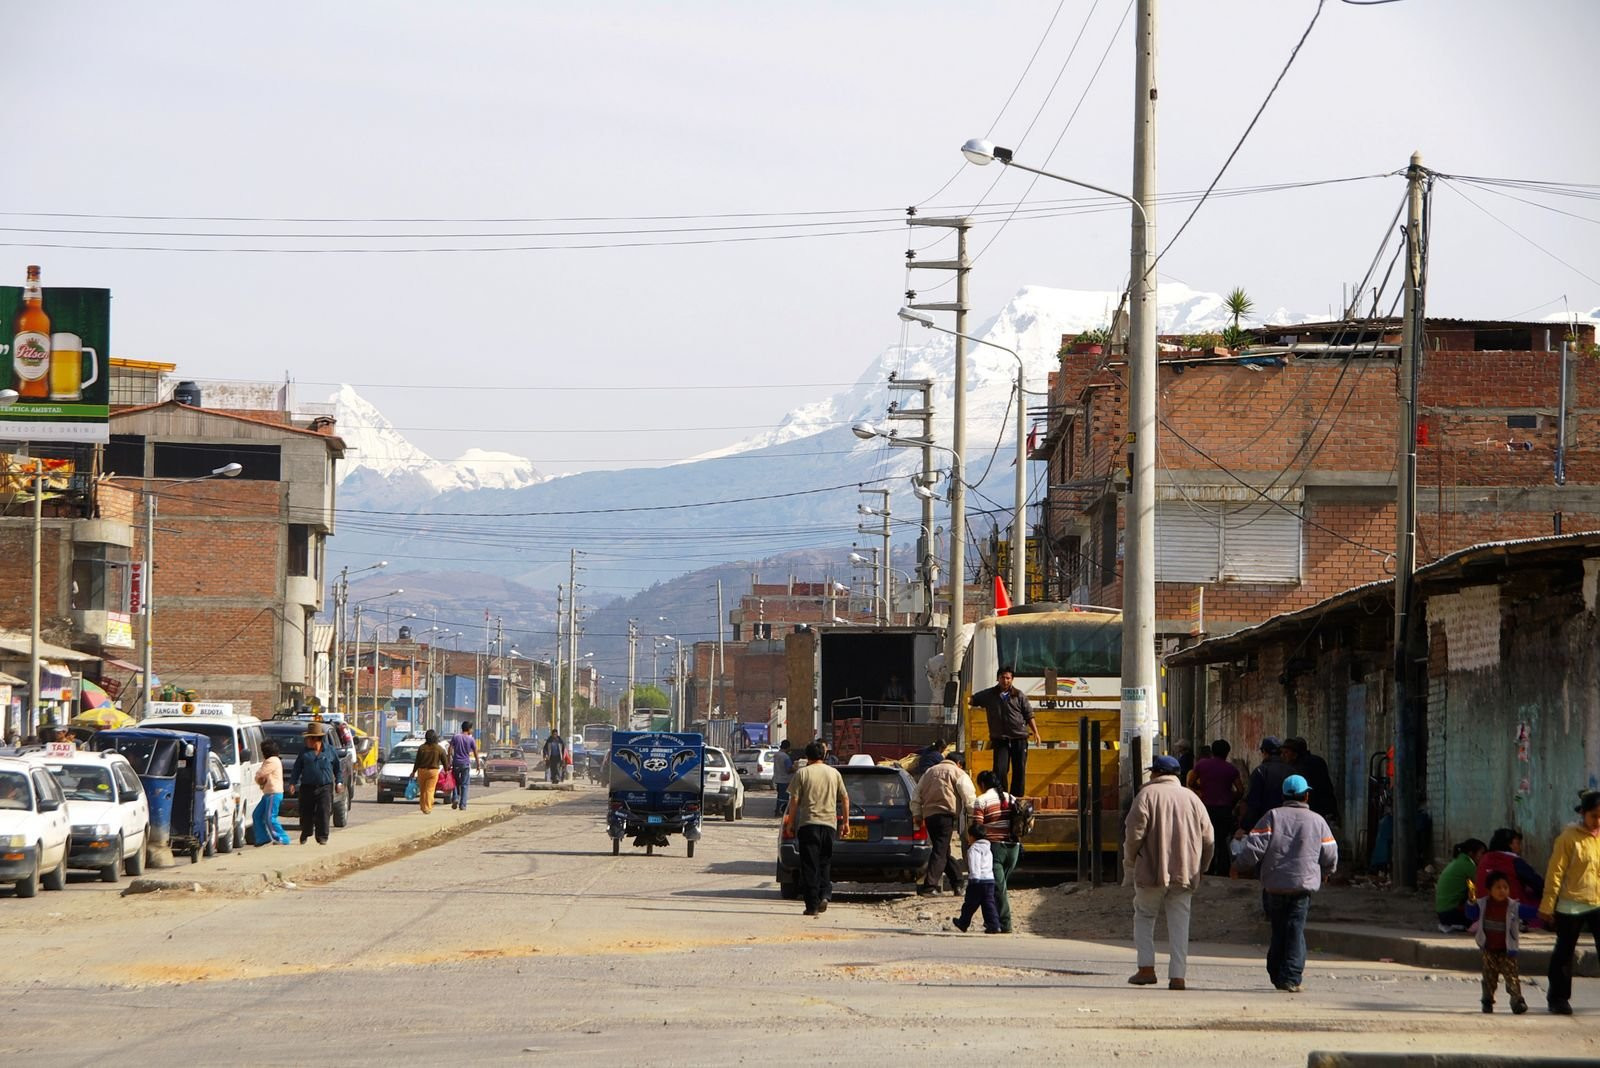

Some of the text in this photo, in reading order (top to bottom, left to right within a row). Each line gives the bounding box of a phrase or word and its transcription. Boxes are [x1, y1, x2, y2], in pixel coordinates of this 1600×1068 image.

[16, 344, 48, 359] Pilsen
[130, 573, 140, 613] PERNOS
[185, 704, 193, 713] E
